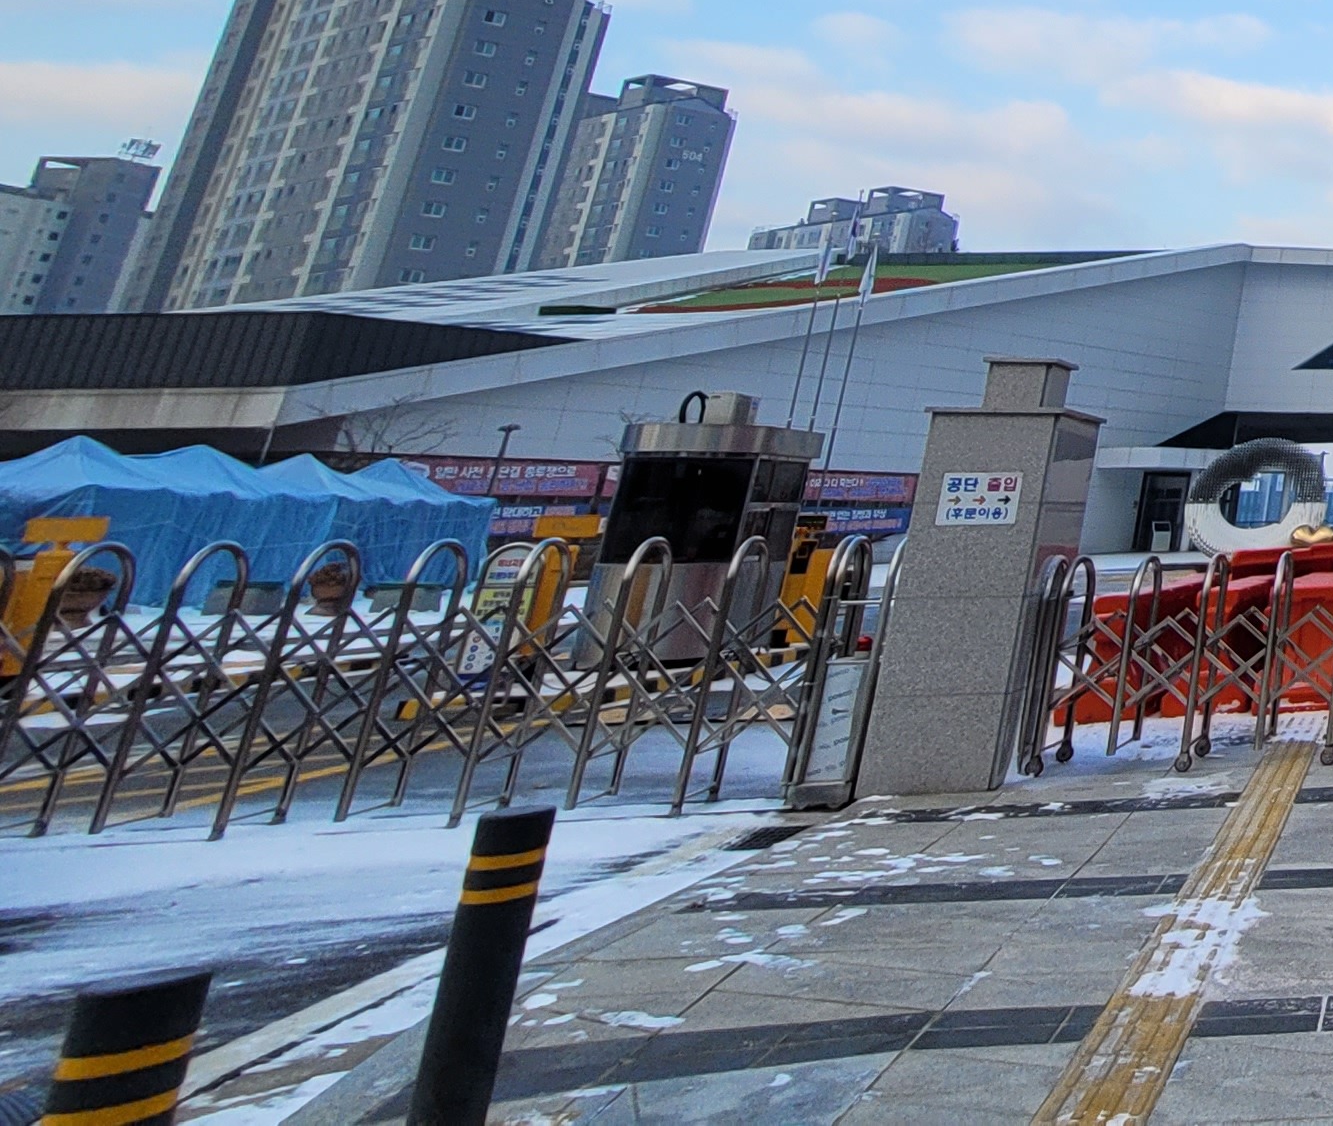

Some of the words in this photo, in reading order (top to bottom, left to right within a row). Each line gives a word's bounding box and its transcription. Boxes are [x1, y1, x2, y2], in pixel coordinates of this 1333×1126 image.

[947, 477, 979, 493] 공단
[987, 476, 1018, 492] 출입
[945, 507, 1009, 520] (후문이용)
